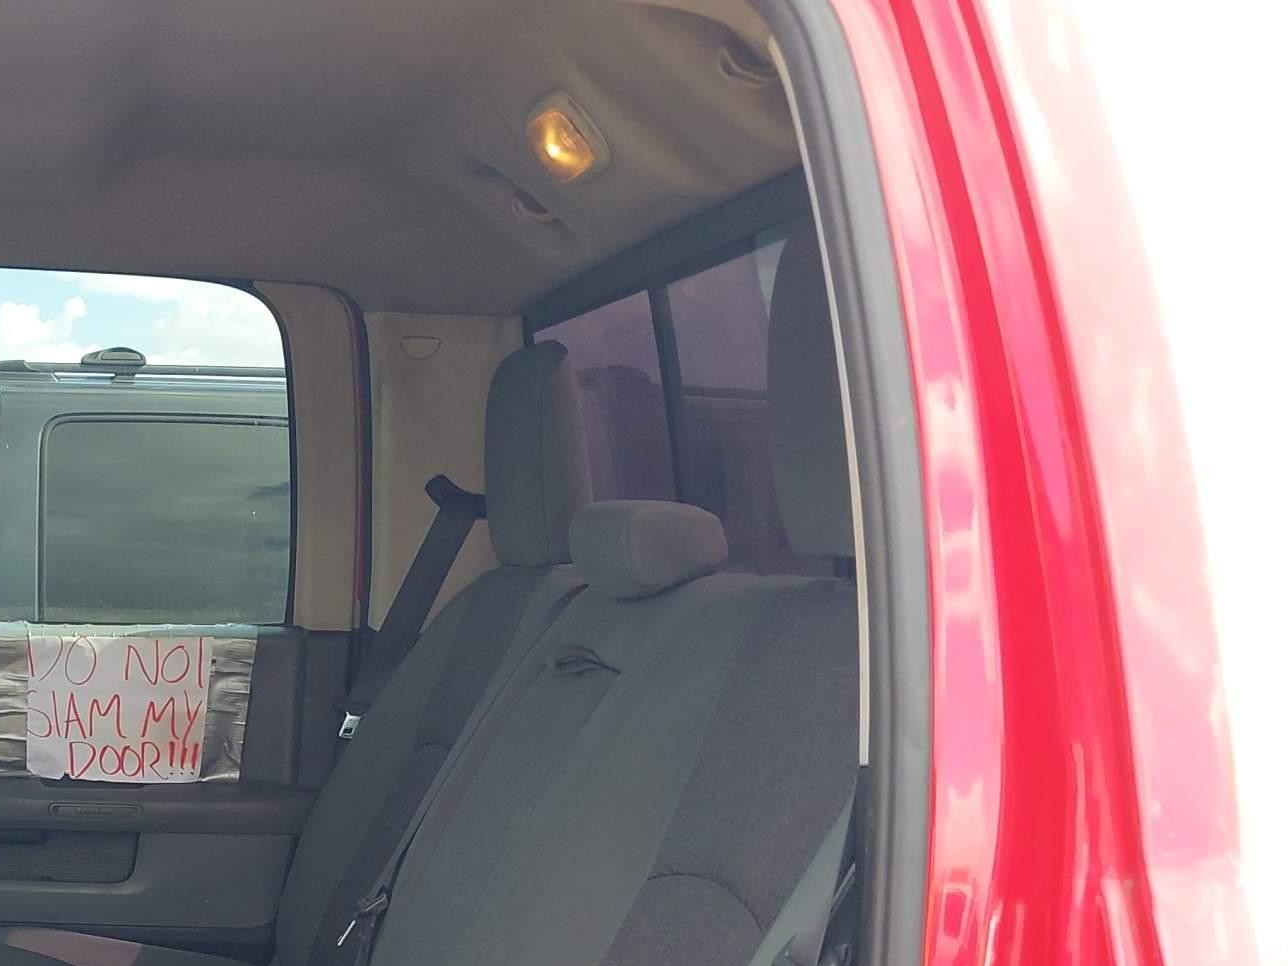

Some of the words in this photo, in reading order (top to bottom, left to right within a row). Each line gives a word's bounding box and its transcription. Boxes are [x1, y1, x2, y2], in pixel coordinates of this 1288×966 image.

[27, 633, 97, 685] DO
[141, 690, 202, 750] MY
[69, 741, 200, 780] DOOR!!!
